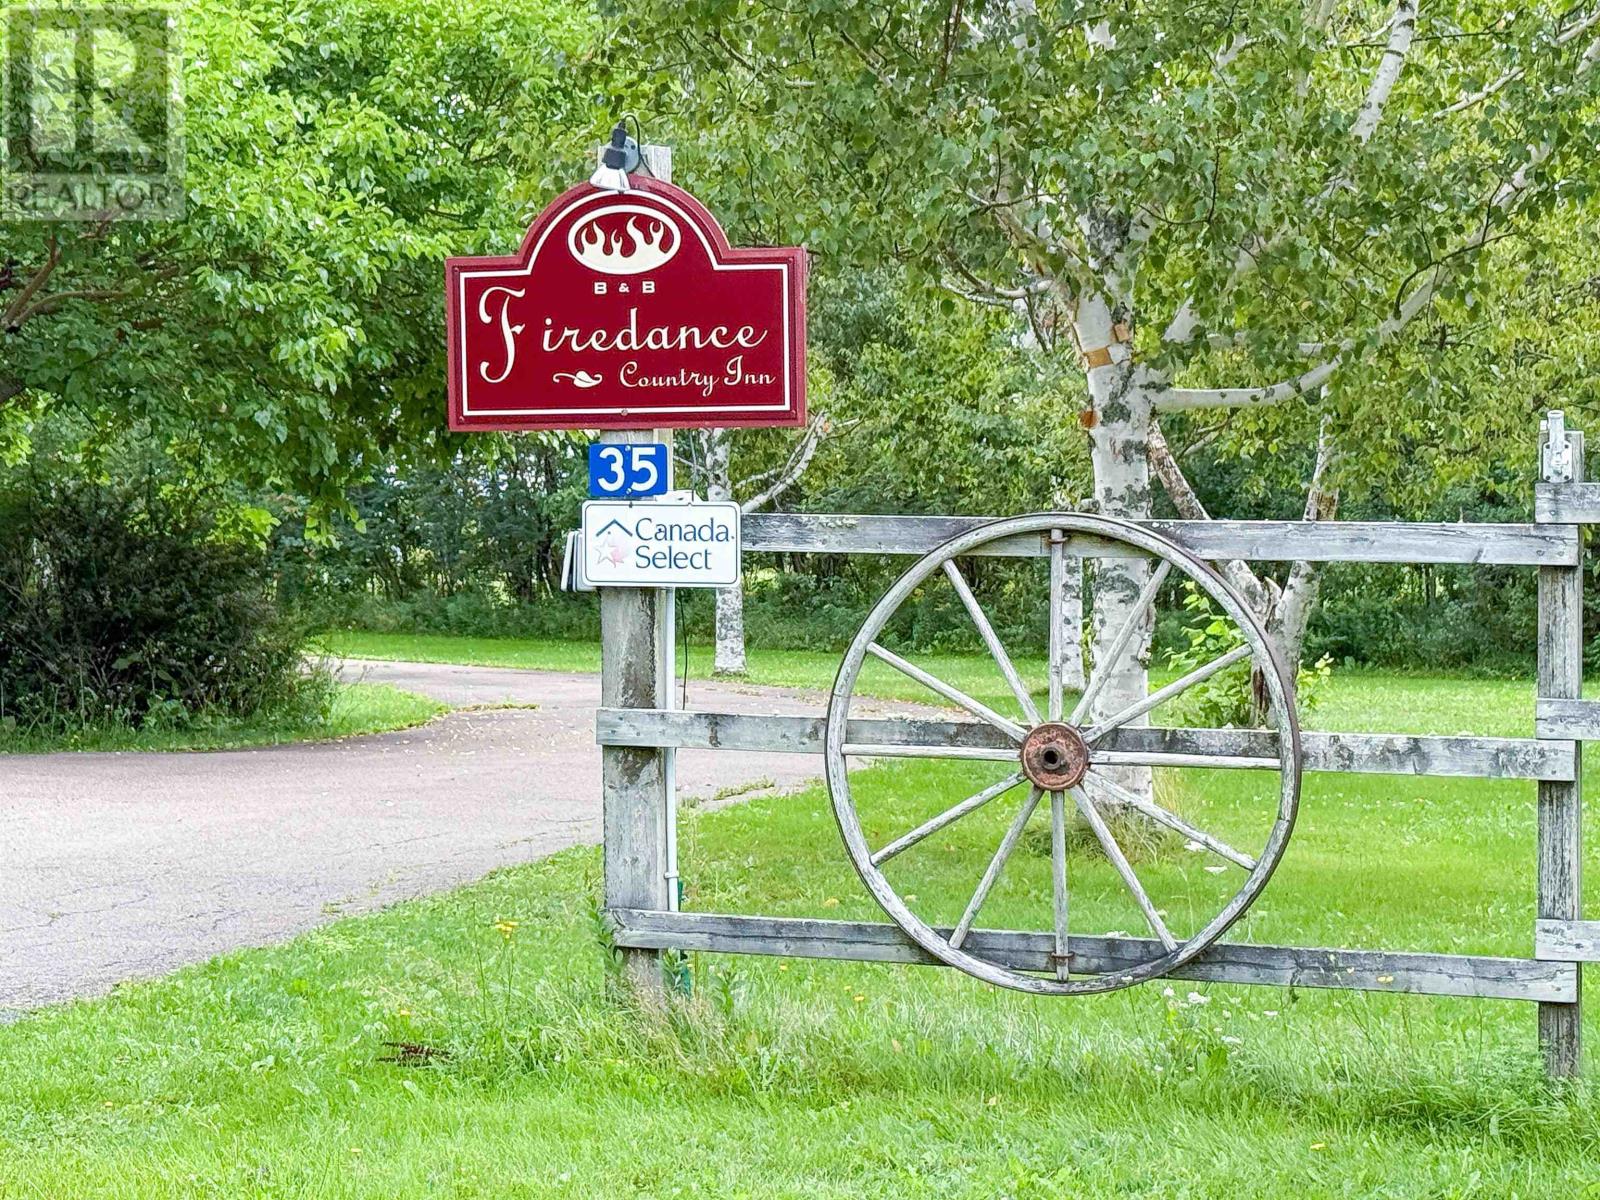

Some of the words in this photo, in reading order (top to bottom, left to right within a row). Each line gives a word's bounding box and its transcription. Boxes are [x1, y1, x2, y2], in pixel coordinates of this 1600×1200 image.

[594, 281, 607, 294] B
[619, 283, 630, 293] &
[642, 281, 656, 294] B
[478, 286, 768, 384] Firedance
[619, 361, 719, 397] Country
[724, 355, 776, 386] Inn
[597, 447, 659, 492] 35
[635, 517, 730, 542] Canada
[635, 545, 713, 570] Select
